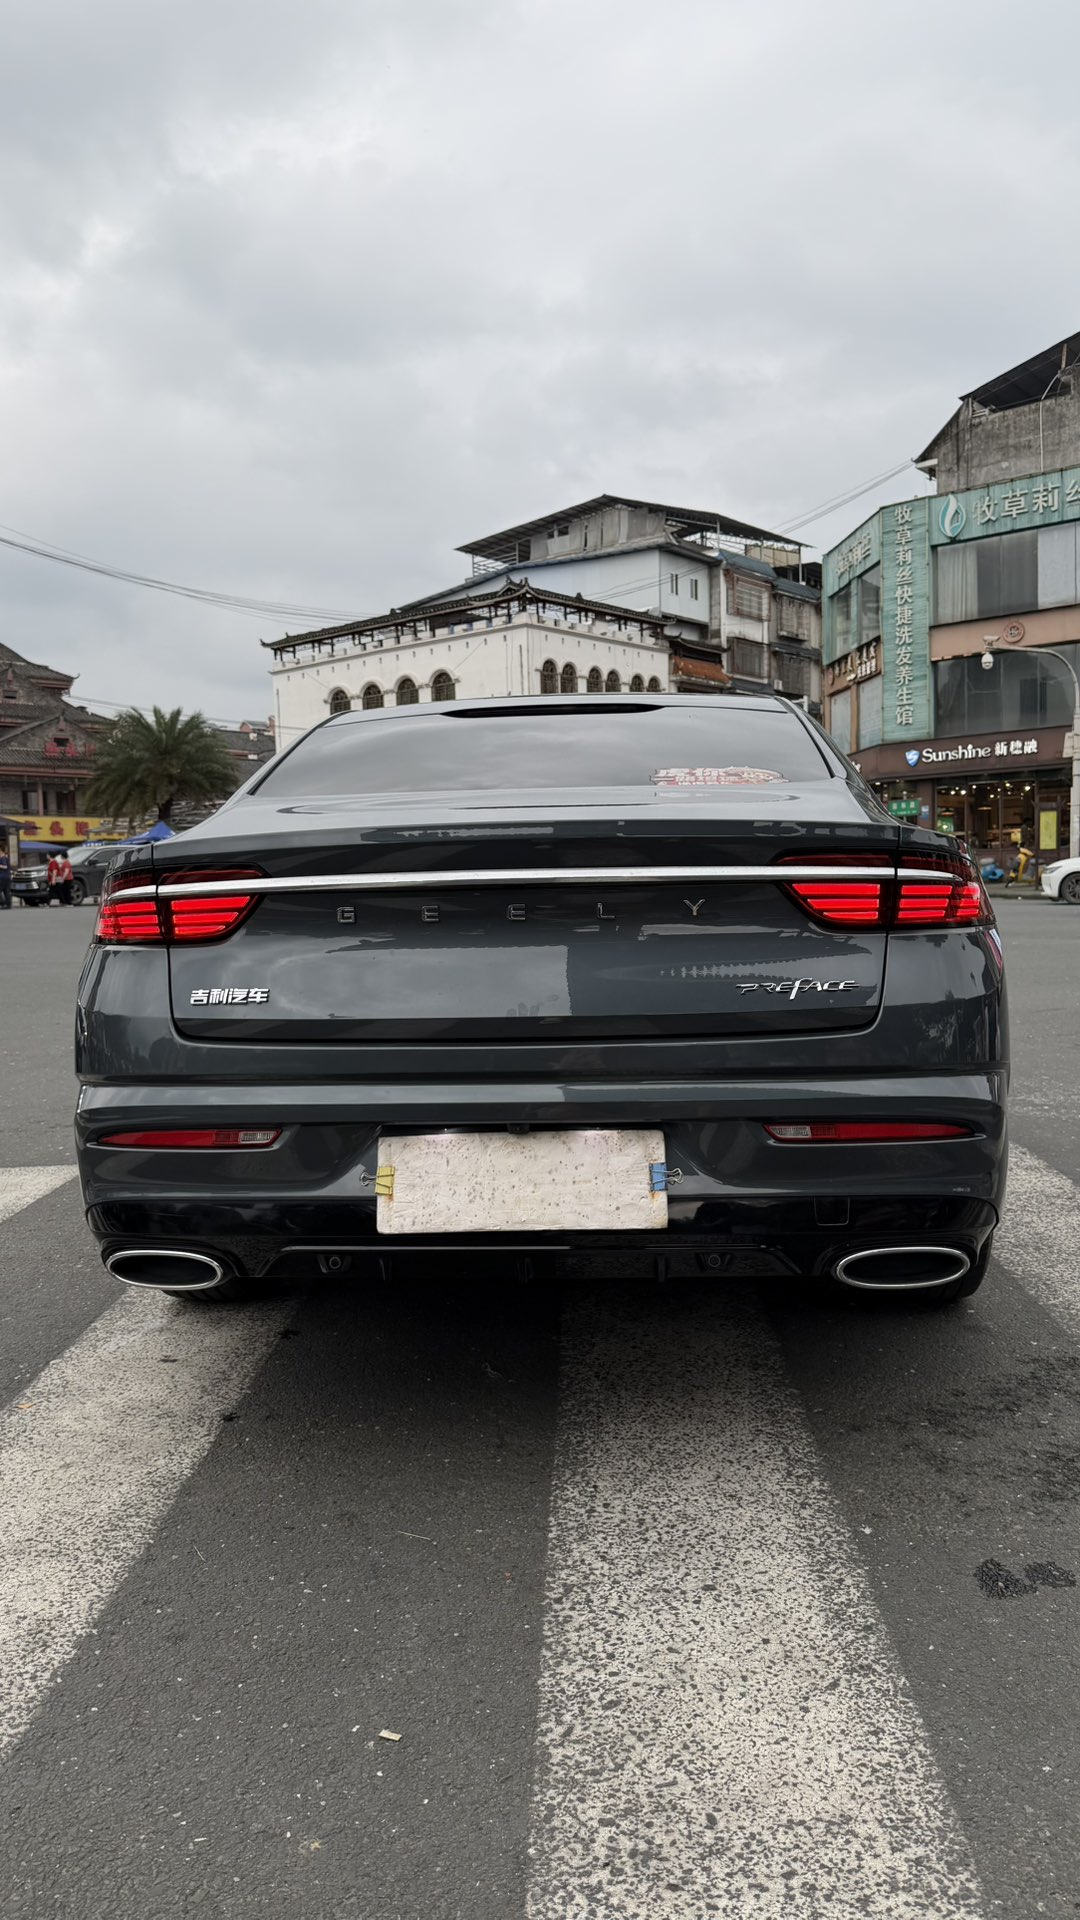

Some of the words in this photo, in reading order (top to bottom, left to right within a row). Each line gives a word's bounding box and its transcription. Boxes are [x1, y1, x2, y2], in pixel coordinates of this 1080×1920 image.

[894, 505, 914, 726] 牧草莉丝快捷洗发养生馆
[921, 744, 992, 763] Sunshine
[336, 899, 706, 924] GEELY
[190, 987, 269, 1005] 吉利汽车
